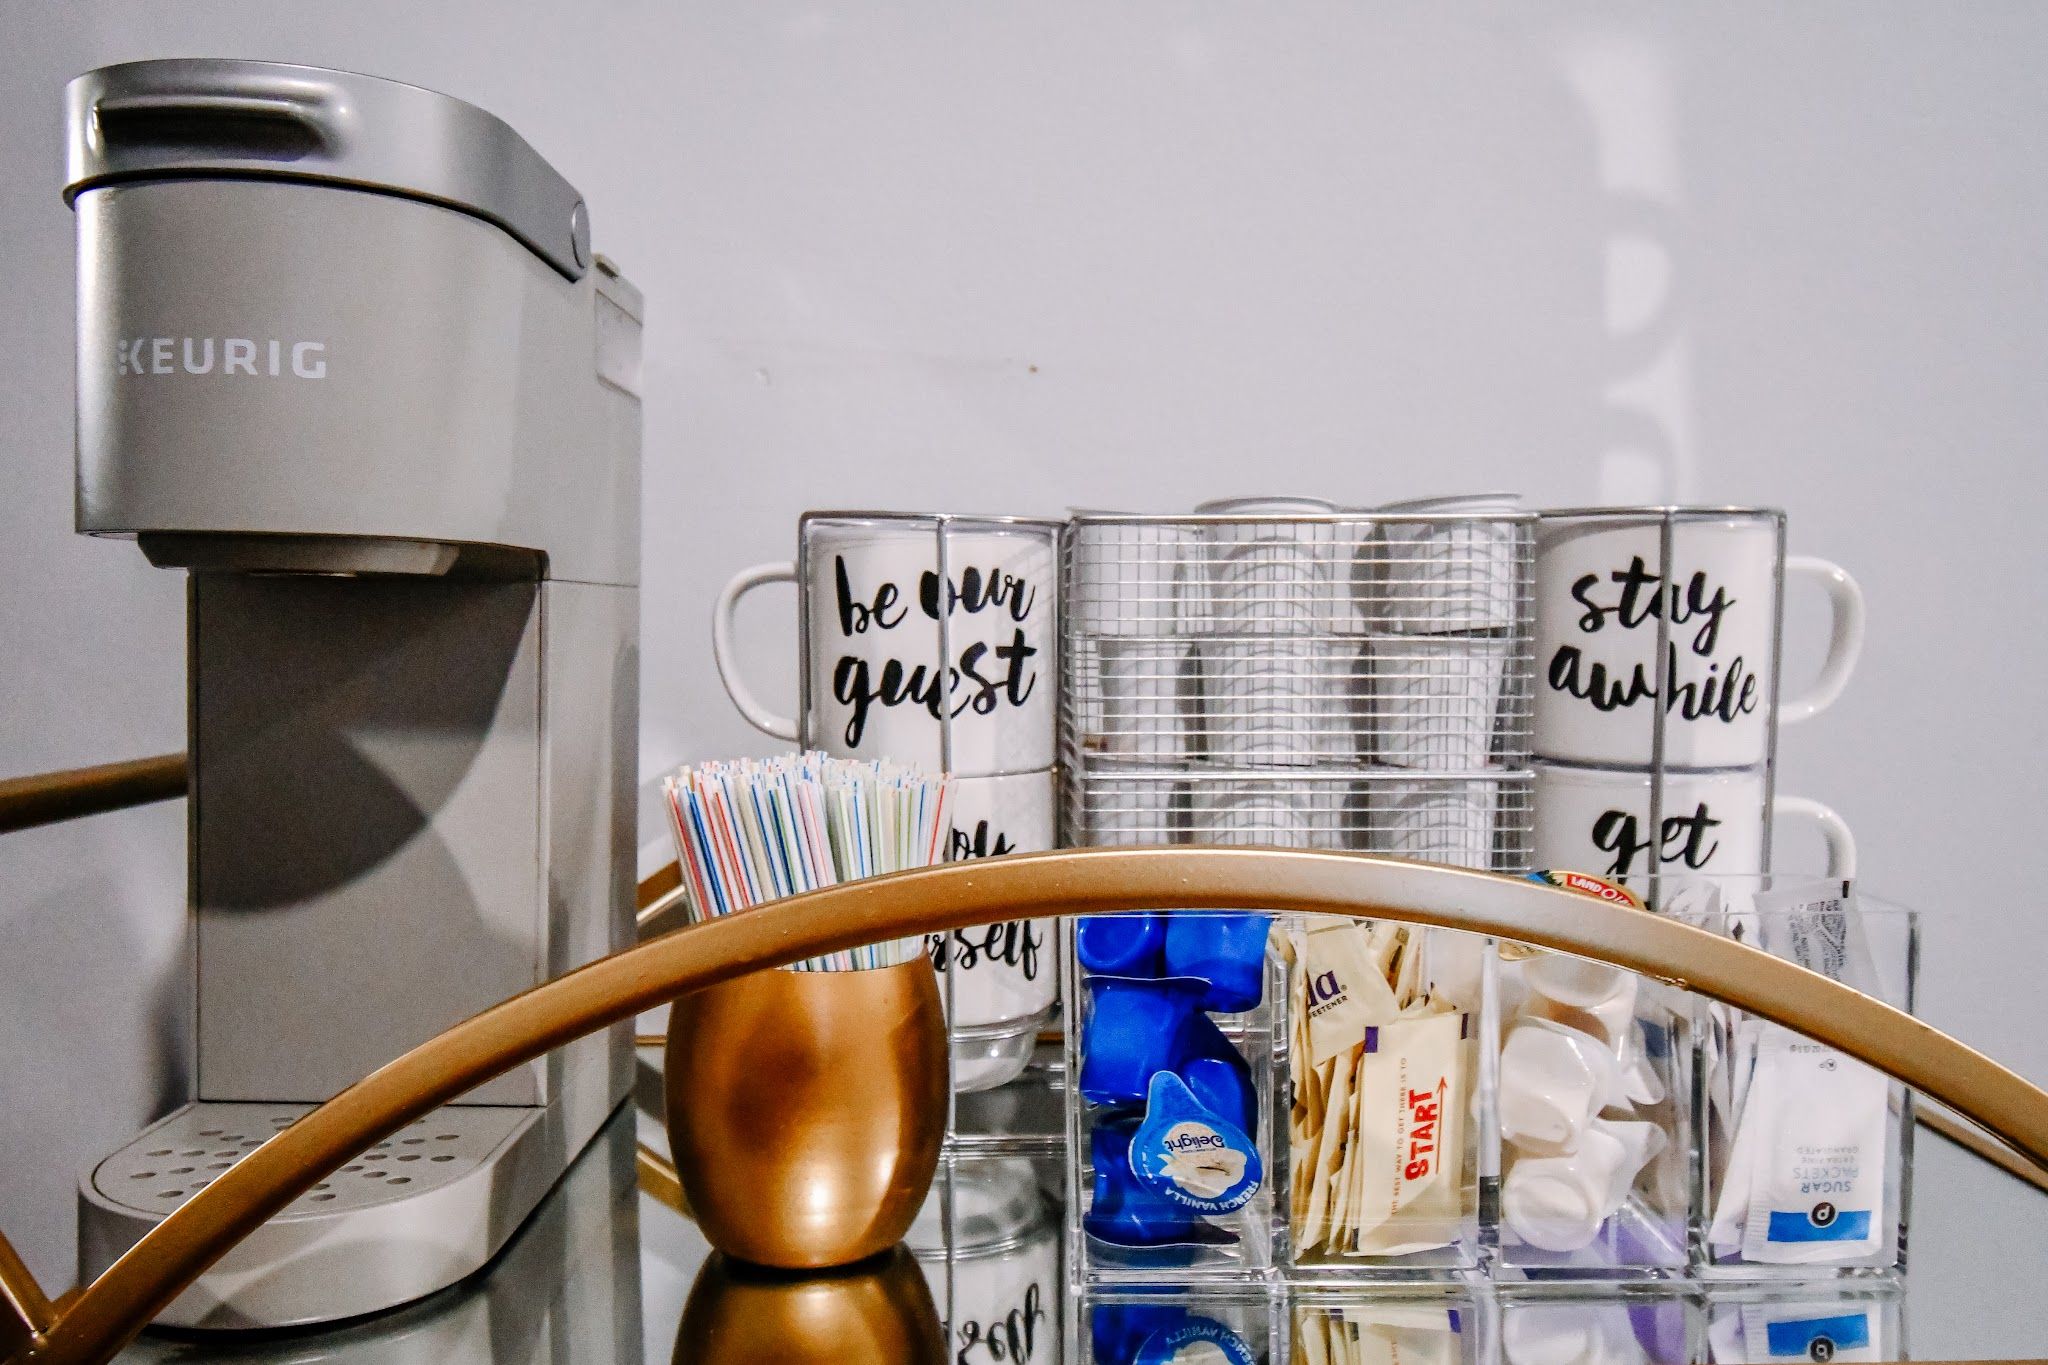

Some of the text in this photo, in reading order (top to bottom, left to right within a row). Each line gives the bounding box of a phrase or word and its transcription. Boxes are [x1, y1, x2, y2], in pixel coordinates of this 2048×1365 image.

[118, 337, 327, 379] KEURIG
[835, 555, 1036, 637] be our
[1571, 555, 1736, 657] stay
[833, 628, 1038, 749] guest
[1548, 641, 1759, 723] awhile
[1591, 802, 1722, 885] get
[1570, 875, 1602, 893] LAND
[1309, 995, 1348, 1018] EETENER
[1164, 1133, 1225, 1152] Delight
[1404, 1088, 1438, 1181] START
[1395, 1153, 1403, 1175] WAY
[1792, 1166, 1859, 1180] PACKETS
[1164, 1180, 1260, 1211] FRENCH VANILLA
[1801, 1181, 1852, 1193] SUGAR
